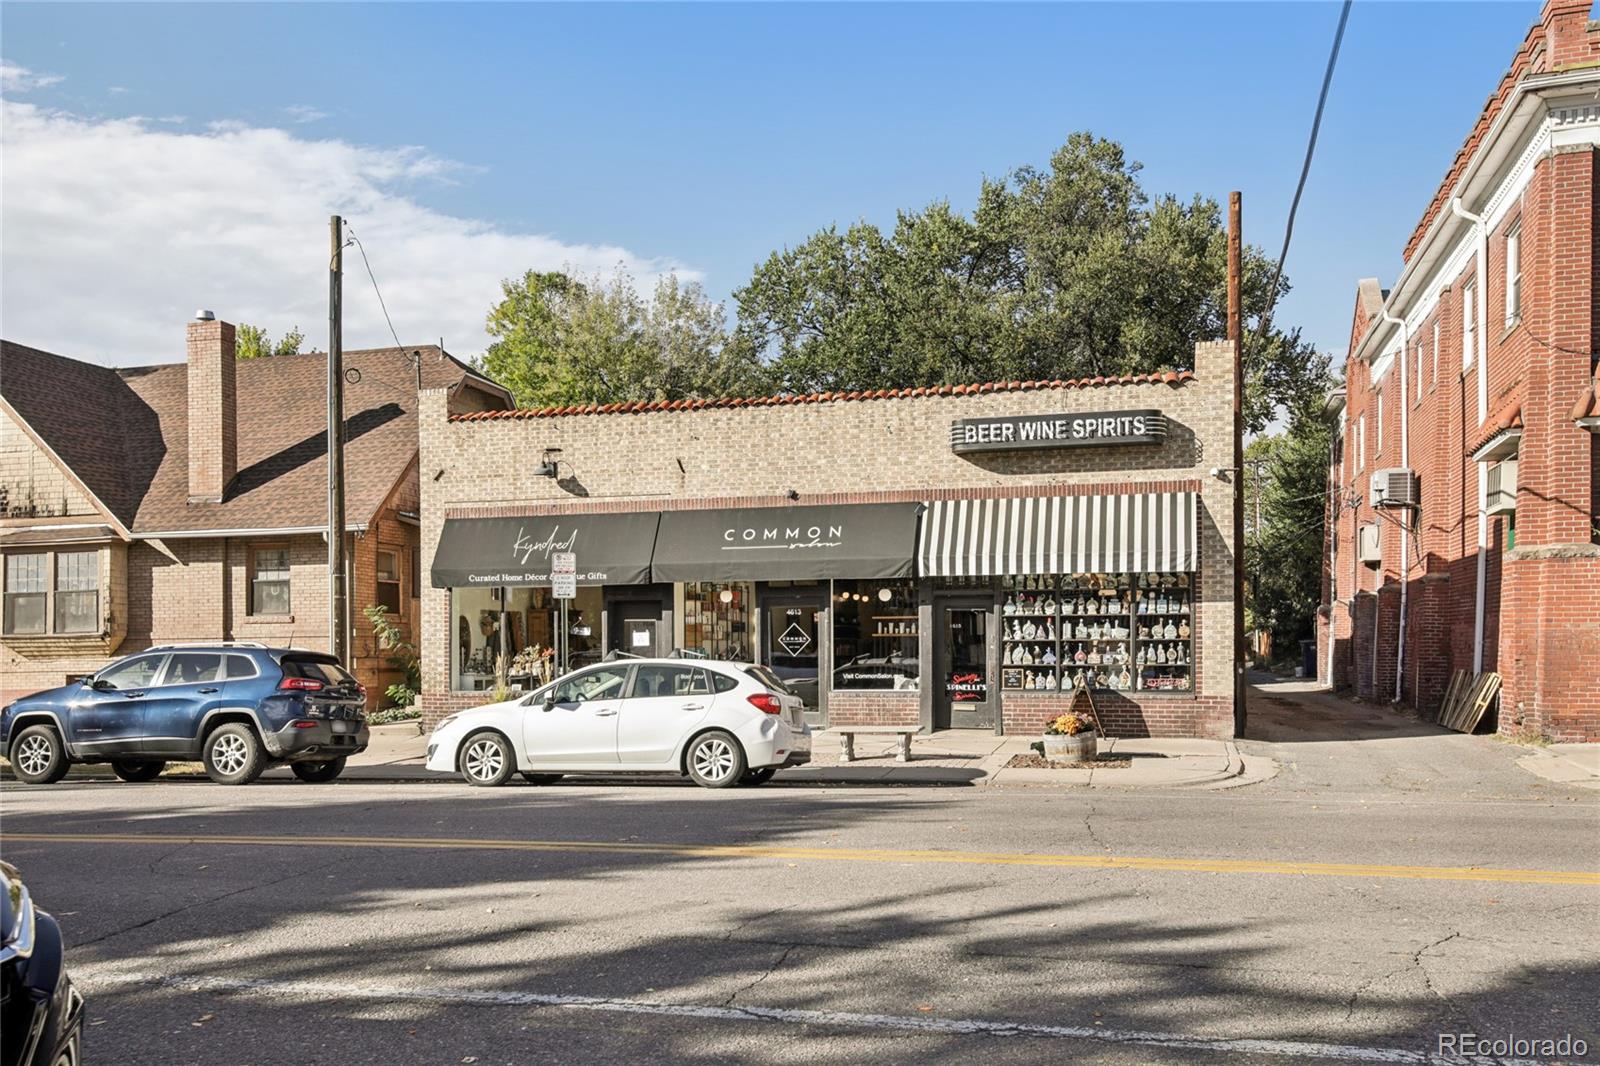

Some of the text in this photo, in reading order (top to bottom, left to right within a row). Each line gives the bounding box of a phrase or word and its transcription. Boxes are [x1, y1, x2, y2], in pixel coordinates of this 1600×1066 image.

[964, 416, 1146, 443] BEER WINE SPIRITS
[724, 525, 842, 541] COMMON
[513, 525, 578, 565] Kyndred
[468, 574, 500, 583] Curated
[502, 573, 523, 582] Home
[587, 571, 607, 581] Gifts
[946, 683, 987, 691] SPINELLI'S
